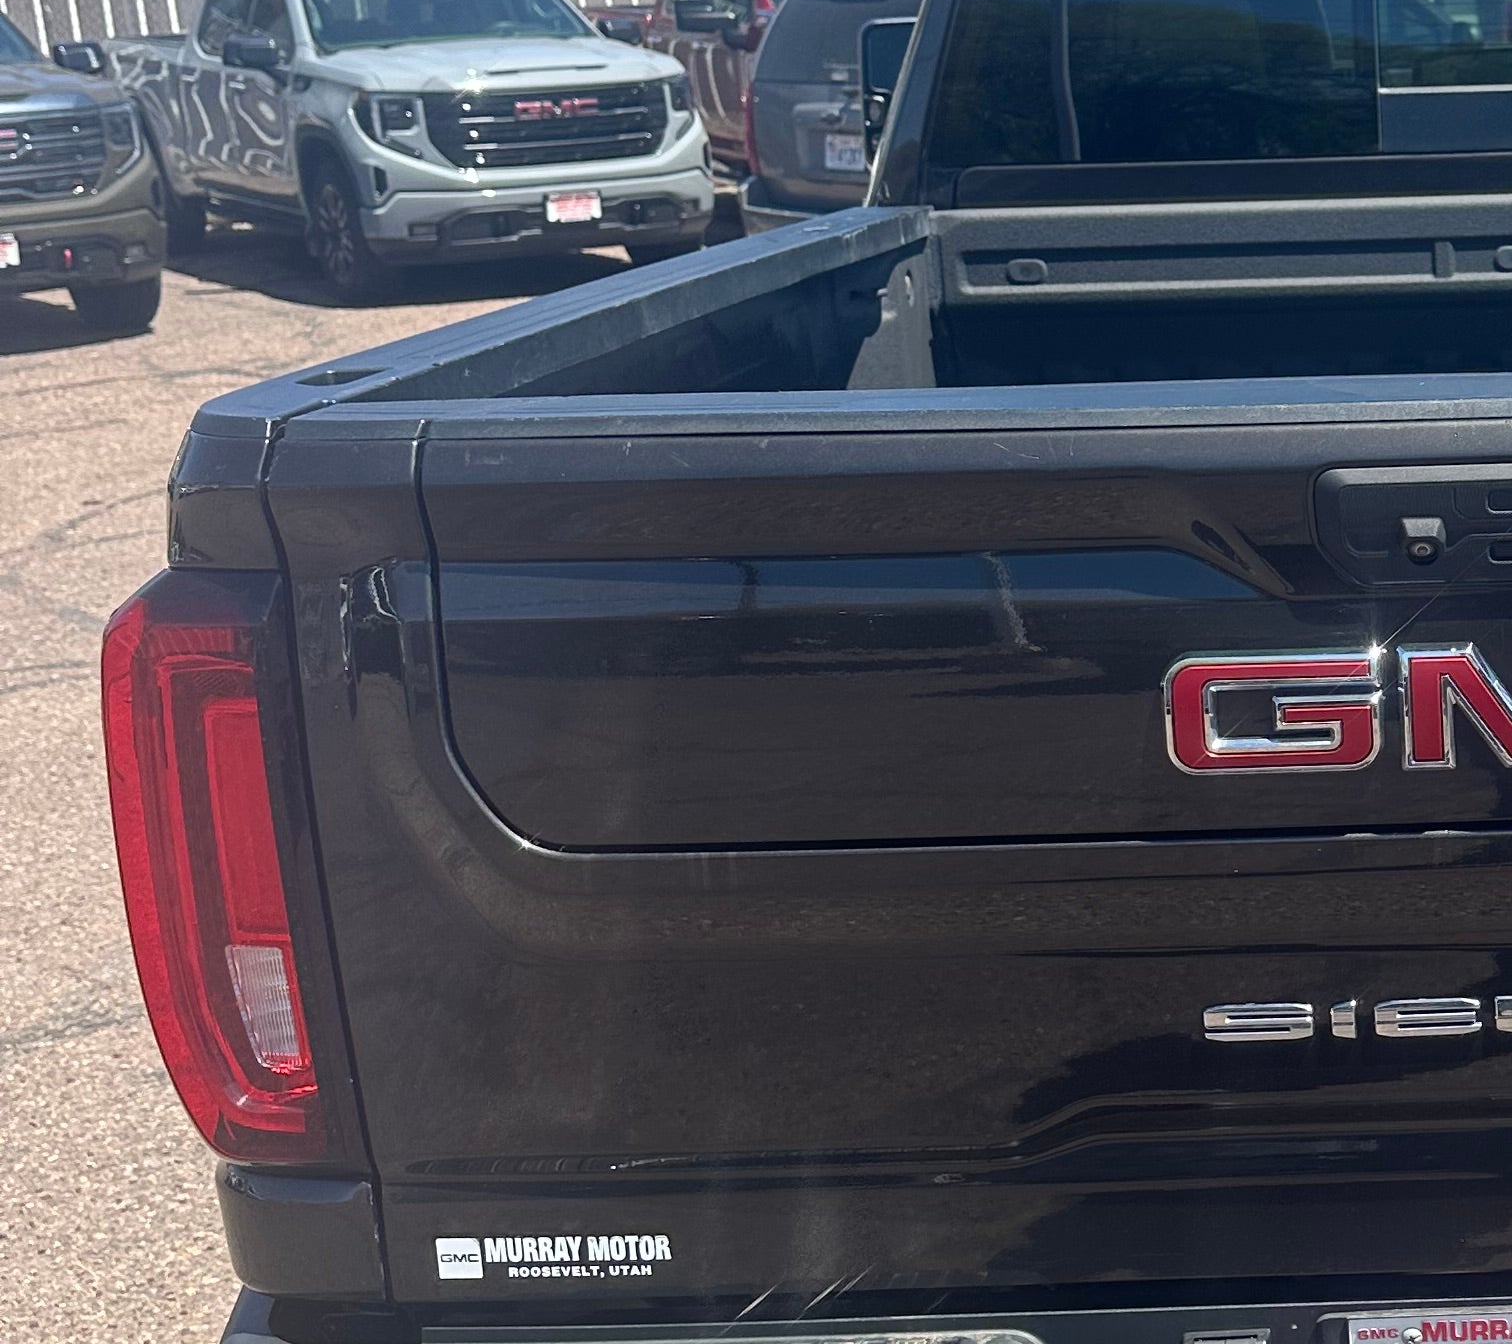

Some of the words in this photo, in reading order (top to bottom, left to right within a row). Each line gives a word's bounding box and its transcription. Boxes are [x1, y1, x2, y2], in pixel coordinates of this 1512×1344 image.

[484, 1236, 581, 1263] MURRAY
[587, 1234, 672, 1261] MOTOR
[440, 1253, 480, 1263] GMC
[508, 1266, 605, 1278] ROOSEVELT,
[609, 1264, 652, 1276] UTAH
[1357, 1328, 1399, 1340] GMC
